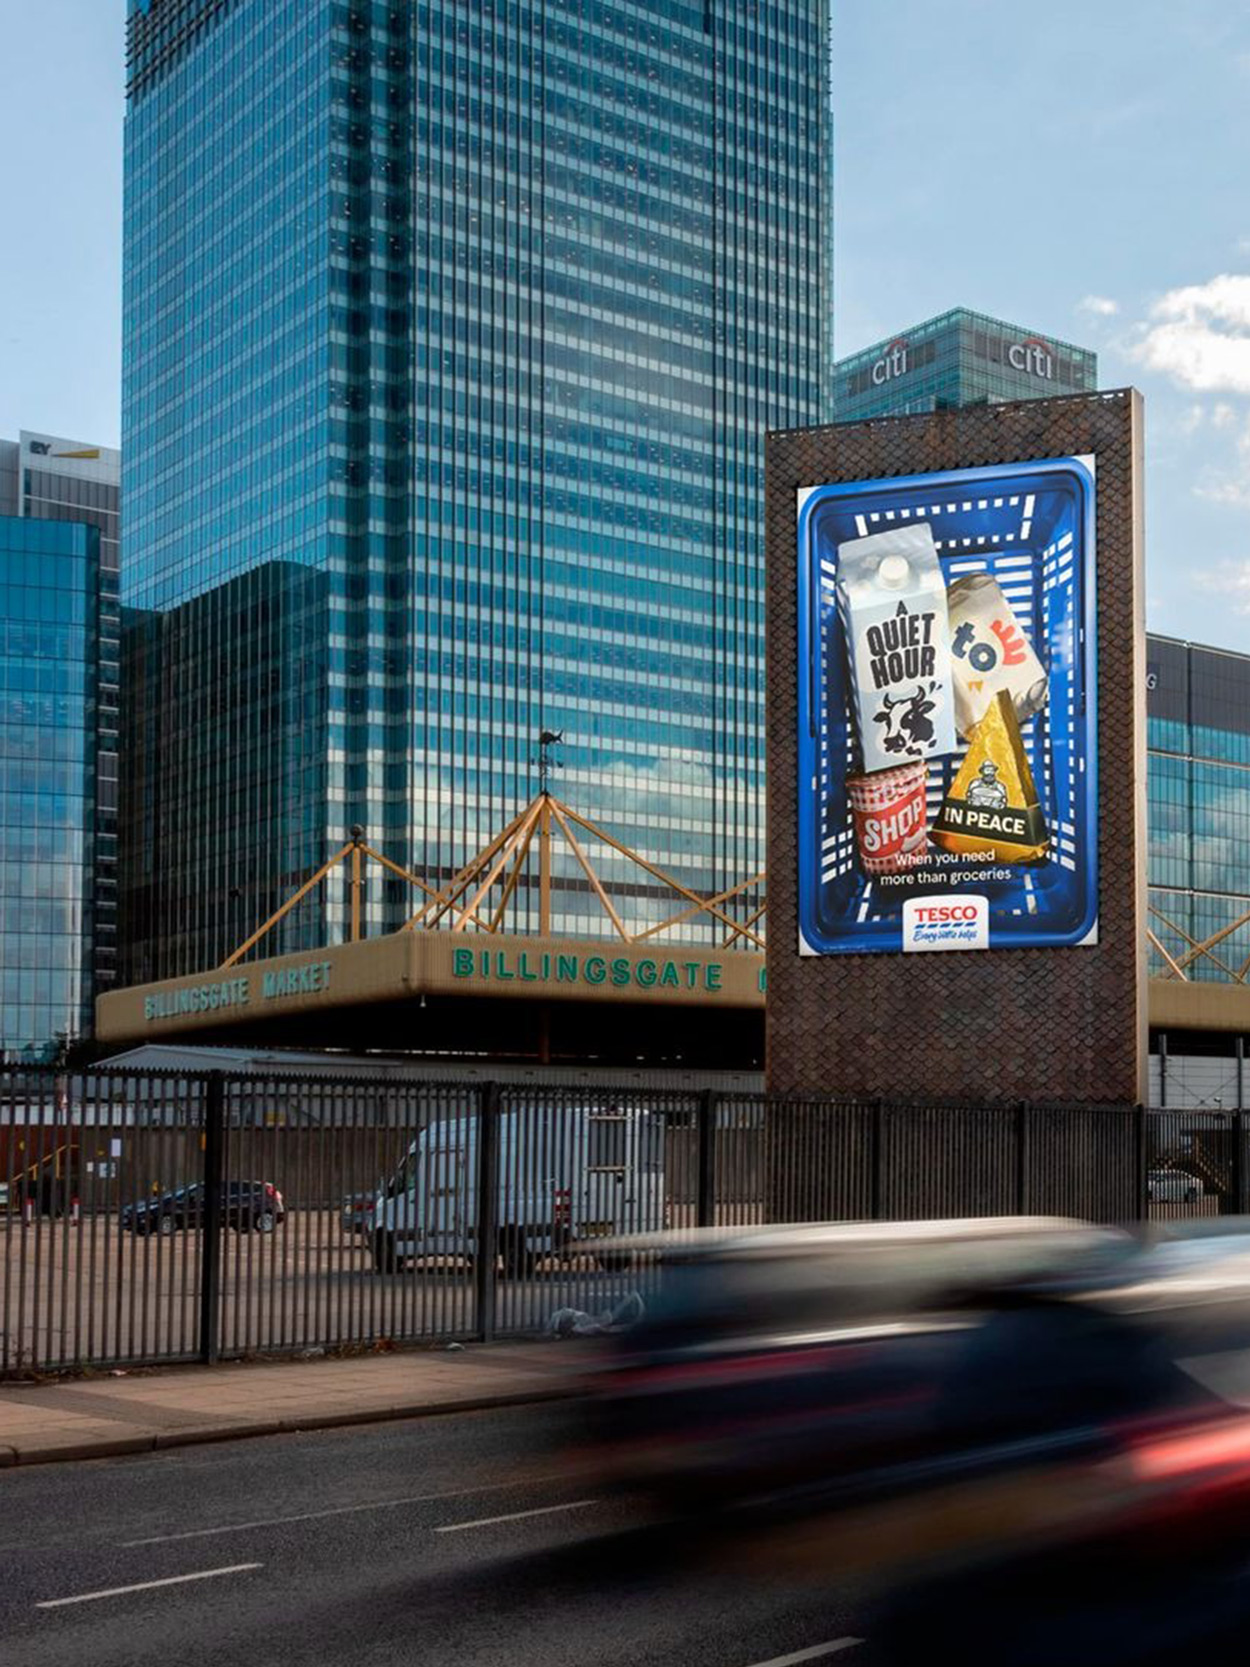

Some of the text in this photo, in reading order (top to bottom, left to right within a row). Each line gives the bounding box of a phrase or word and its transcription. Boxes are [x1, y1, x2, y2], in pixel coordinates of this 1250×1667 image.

[872, 346, 907, 386] citi
[1008, 344, 1052, 379] citi
[29, 440, 51, 456] EY
[896, 600, 908, 617] A
[866, 612, 935, 657] QUIET
[870, 645, 935, 690] HOUR
[863, 795, 923, 852] SHOP
[944, 806, 1026, 836] IN PEACE
[894, 848, 996, 867] When you need
[880, 867, 1012, 886] more than groceries
[914, 906, 978, 922] TESCO
[453, 948, 724, 991] BILLINGSGATE
[144, 962, 331, 1020] BILLINGSGATE MARKET
